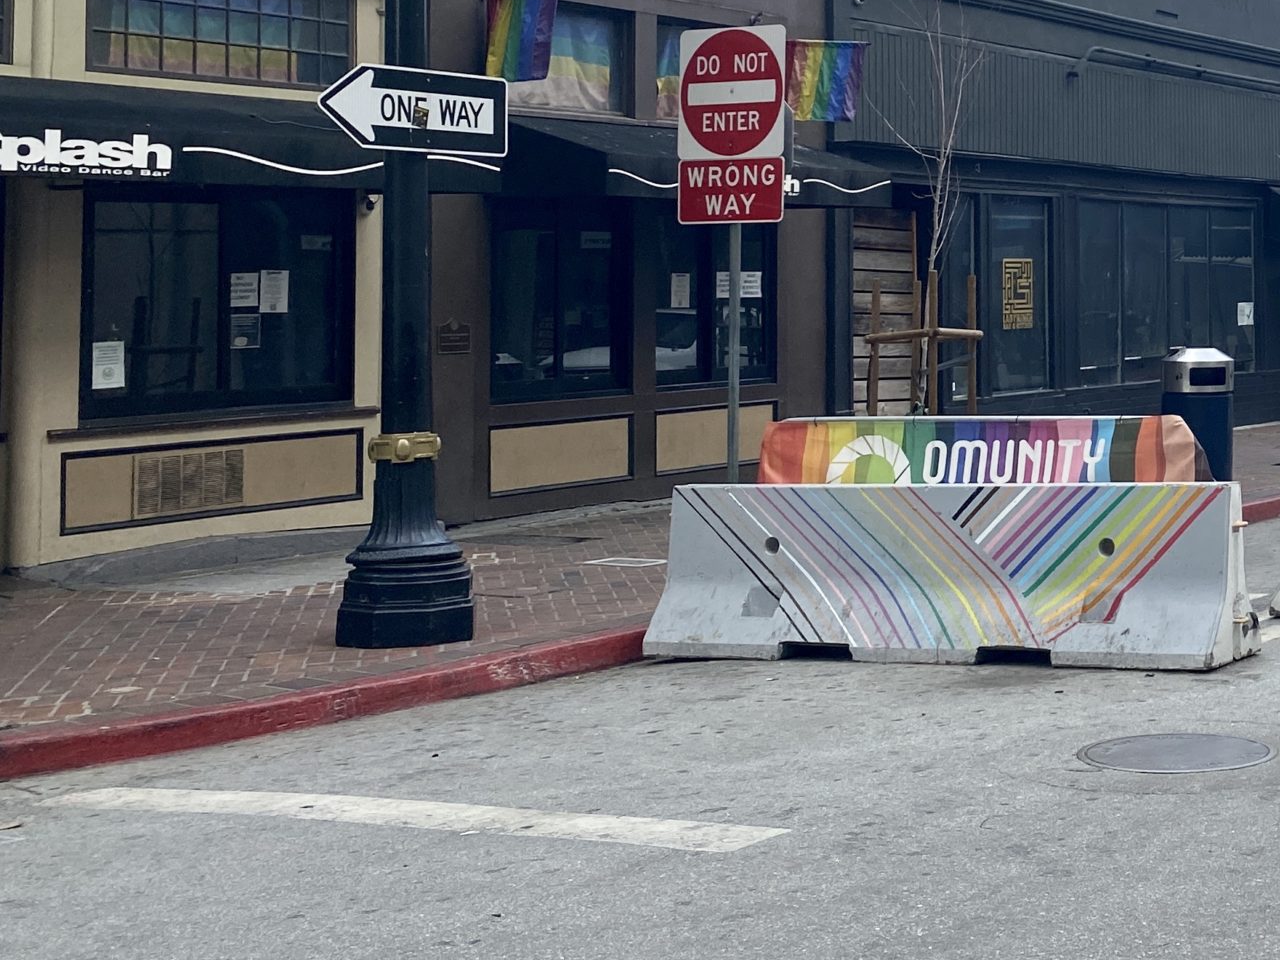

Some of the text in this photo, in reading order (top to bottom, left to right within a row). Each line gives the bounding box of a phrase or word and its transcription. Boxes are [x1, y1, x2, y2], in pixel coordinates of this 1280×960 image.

[696, 52, 768, 75] DO NOT
[439, 98, 484, 128] WAY
[702, 111, 760, 133] ENTER
[0, 129, 172, 171] plash
[20, 164, 71, 173] Video
[78, 166, 133, 176] Dance
[687, 164, 775, 188] WRONG
[705, 193, 756, 216] WAY
